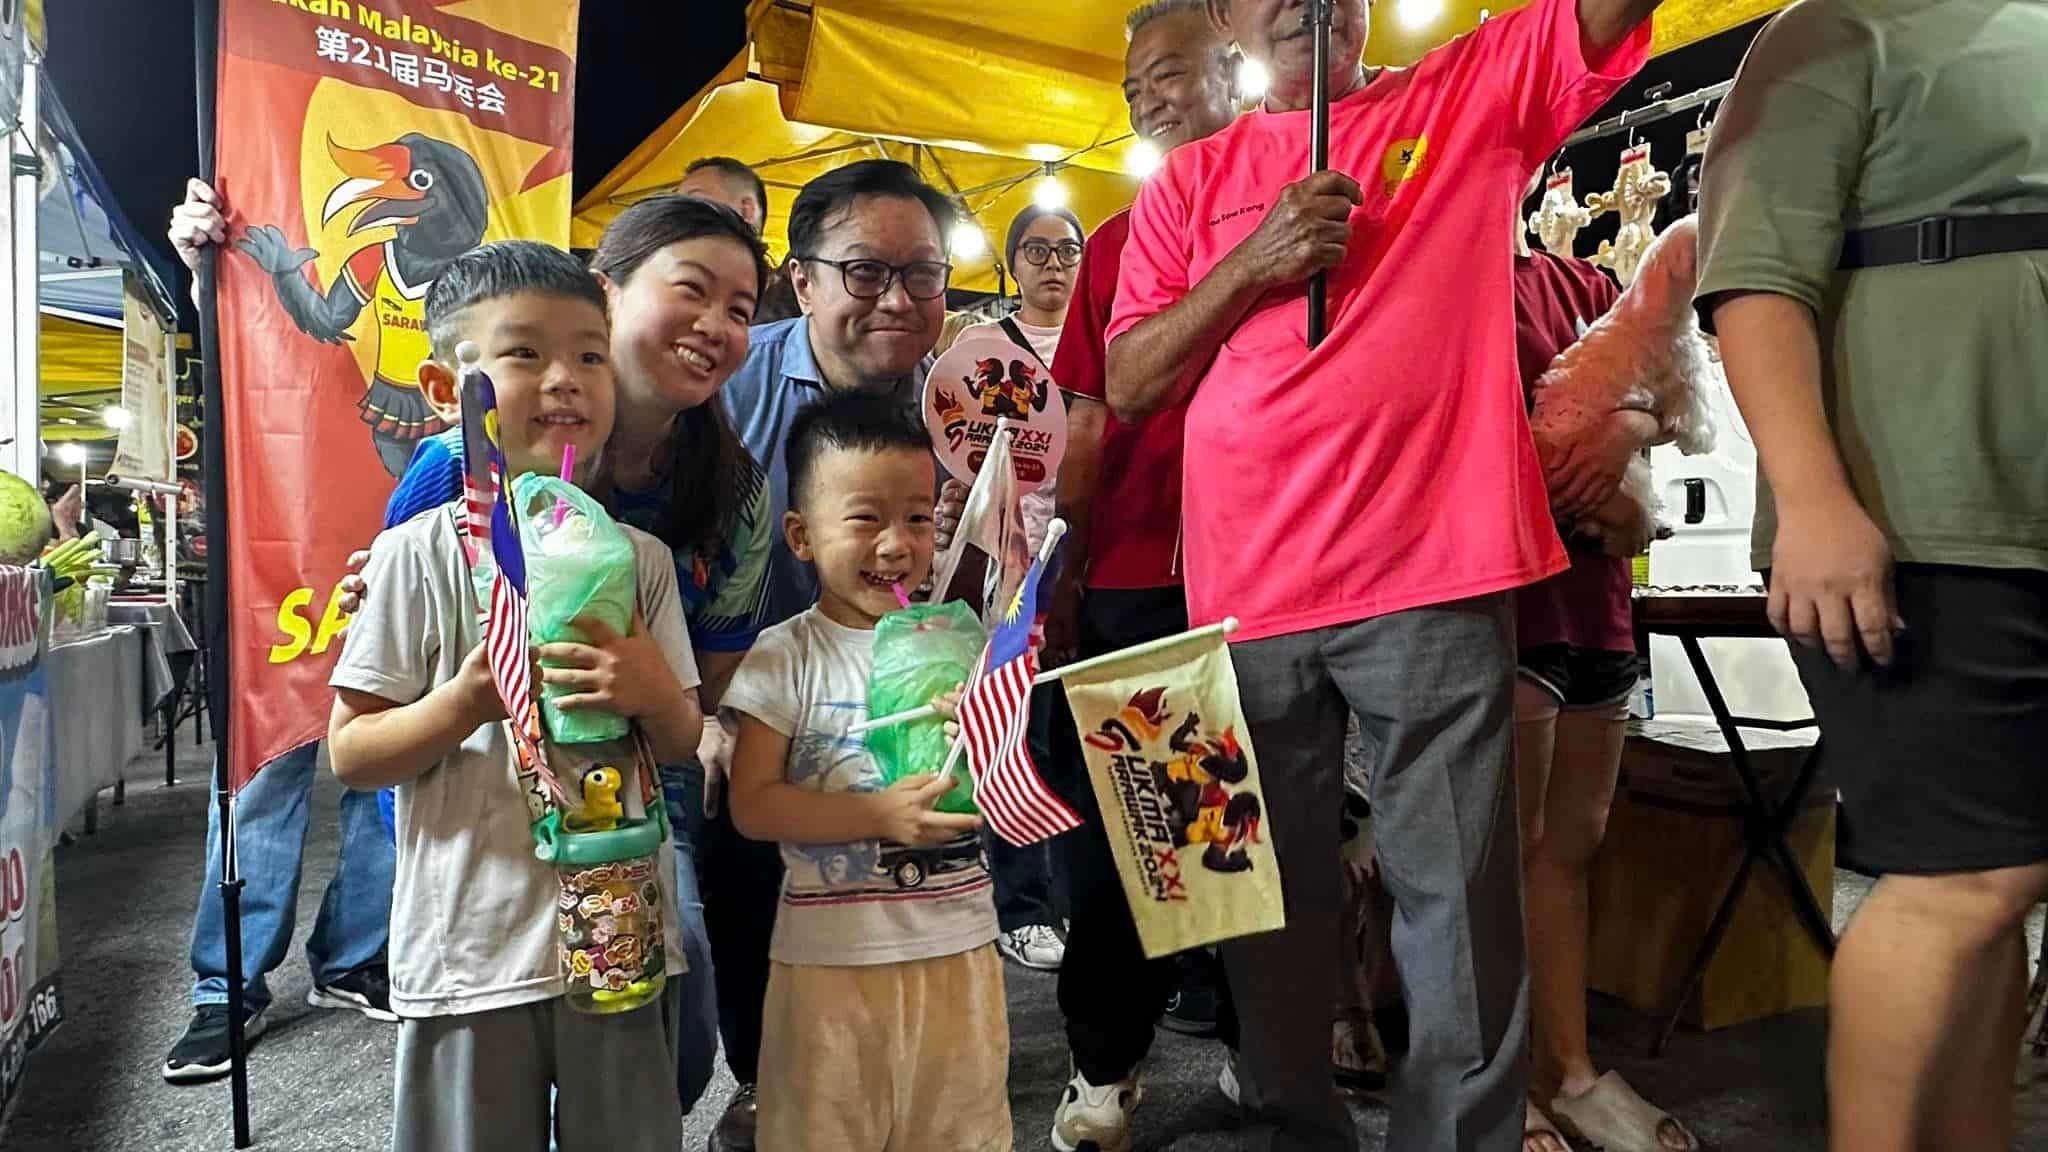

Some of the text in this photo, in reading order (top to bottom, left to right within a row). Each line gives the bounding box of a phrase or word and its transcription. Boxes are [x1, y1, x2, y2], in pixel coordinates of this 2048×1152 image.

[315, 25, 506, 116] 第21届马运会
[357, 4, 479, 68] Malaysia
[486, 48, 560, 93] ke-21
[383, 313, 425, 332] SARA
[1016, 440, 1050, 454] 2024
